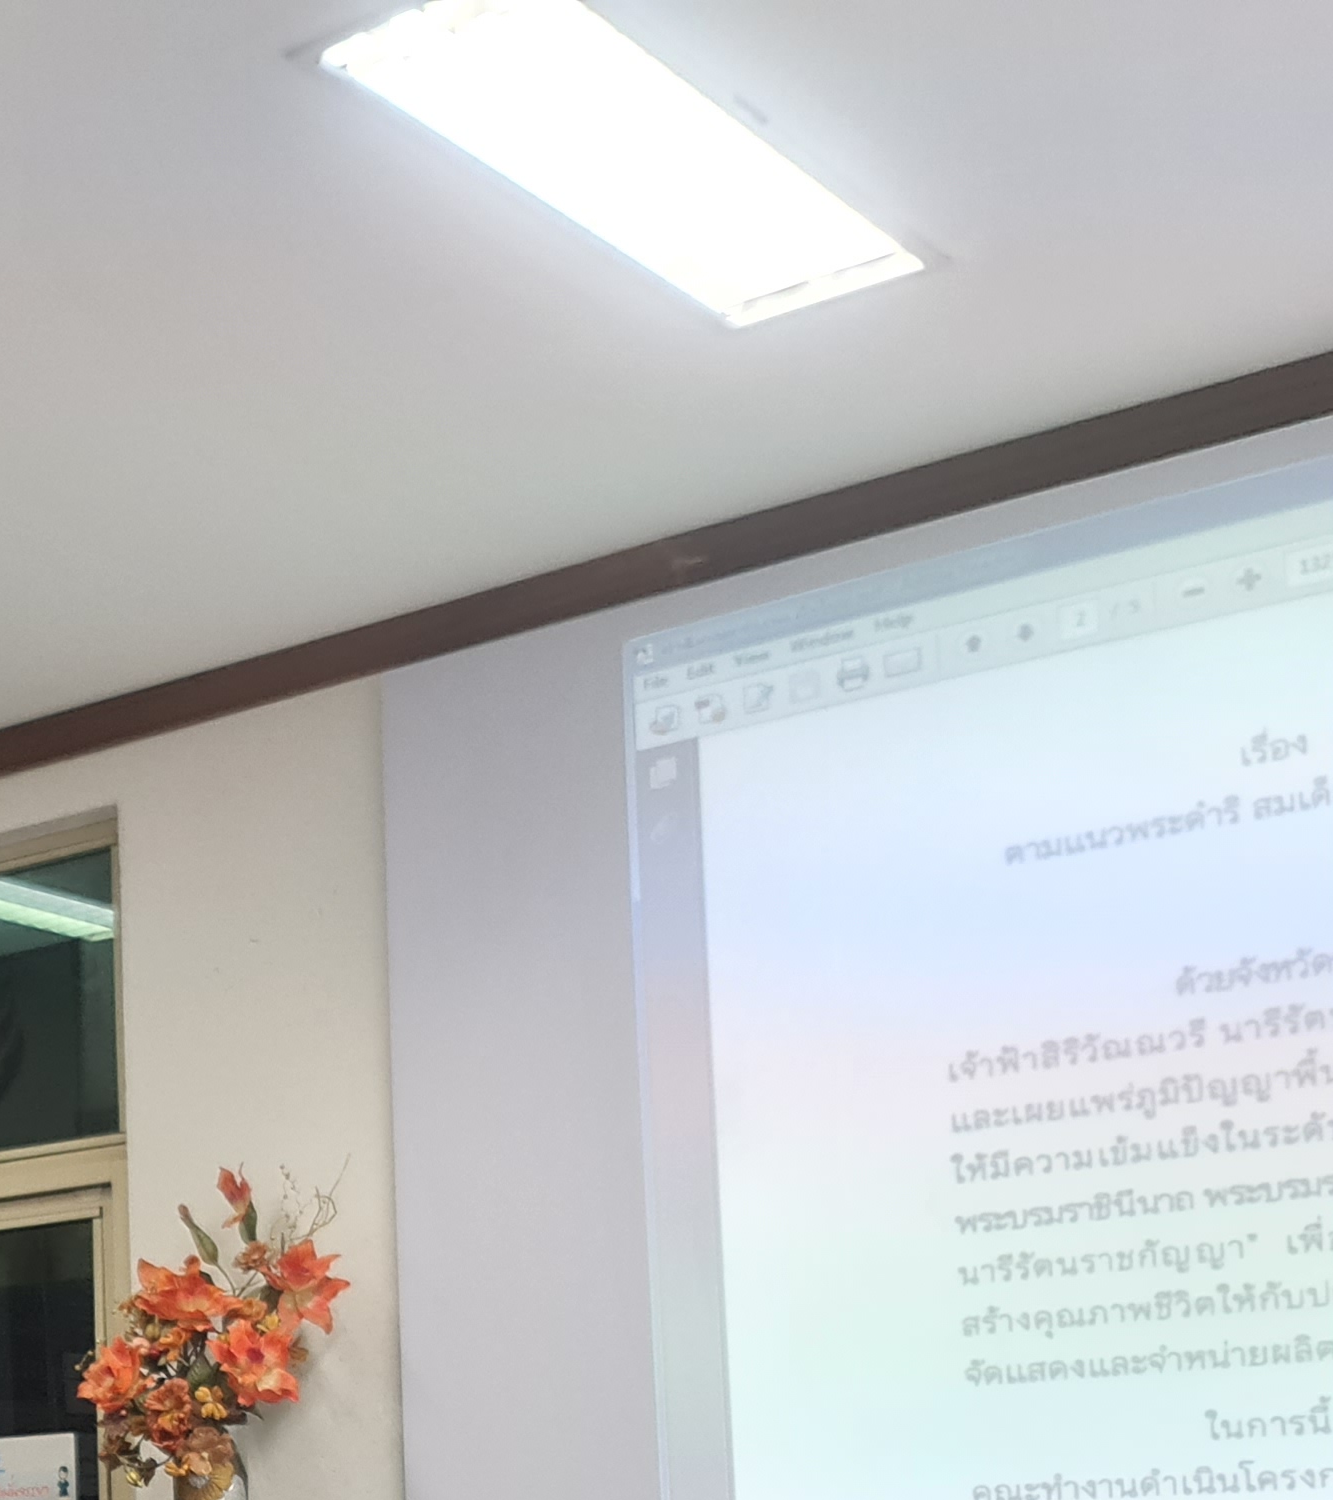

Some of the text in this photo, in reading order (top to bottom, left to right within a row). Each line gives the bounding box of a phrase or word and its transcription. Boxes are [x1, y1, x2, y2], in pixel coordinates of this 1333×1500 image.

[1240, 727, 1308, 767] เรื่อง
[1204, 1394, 1332, 1441] ในการนี้
